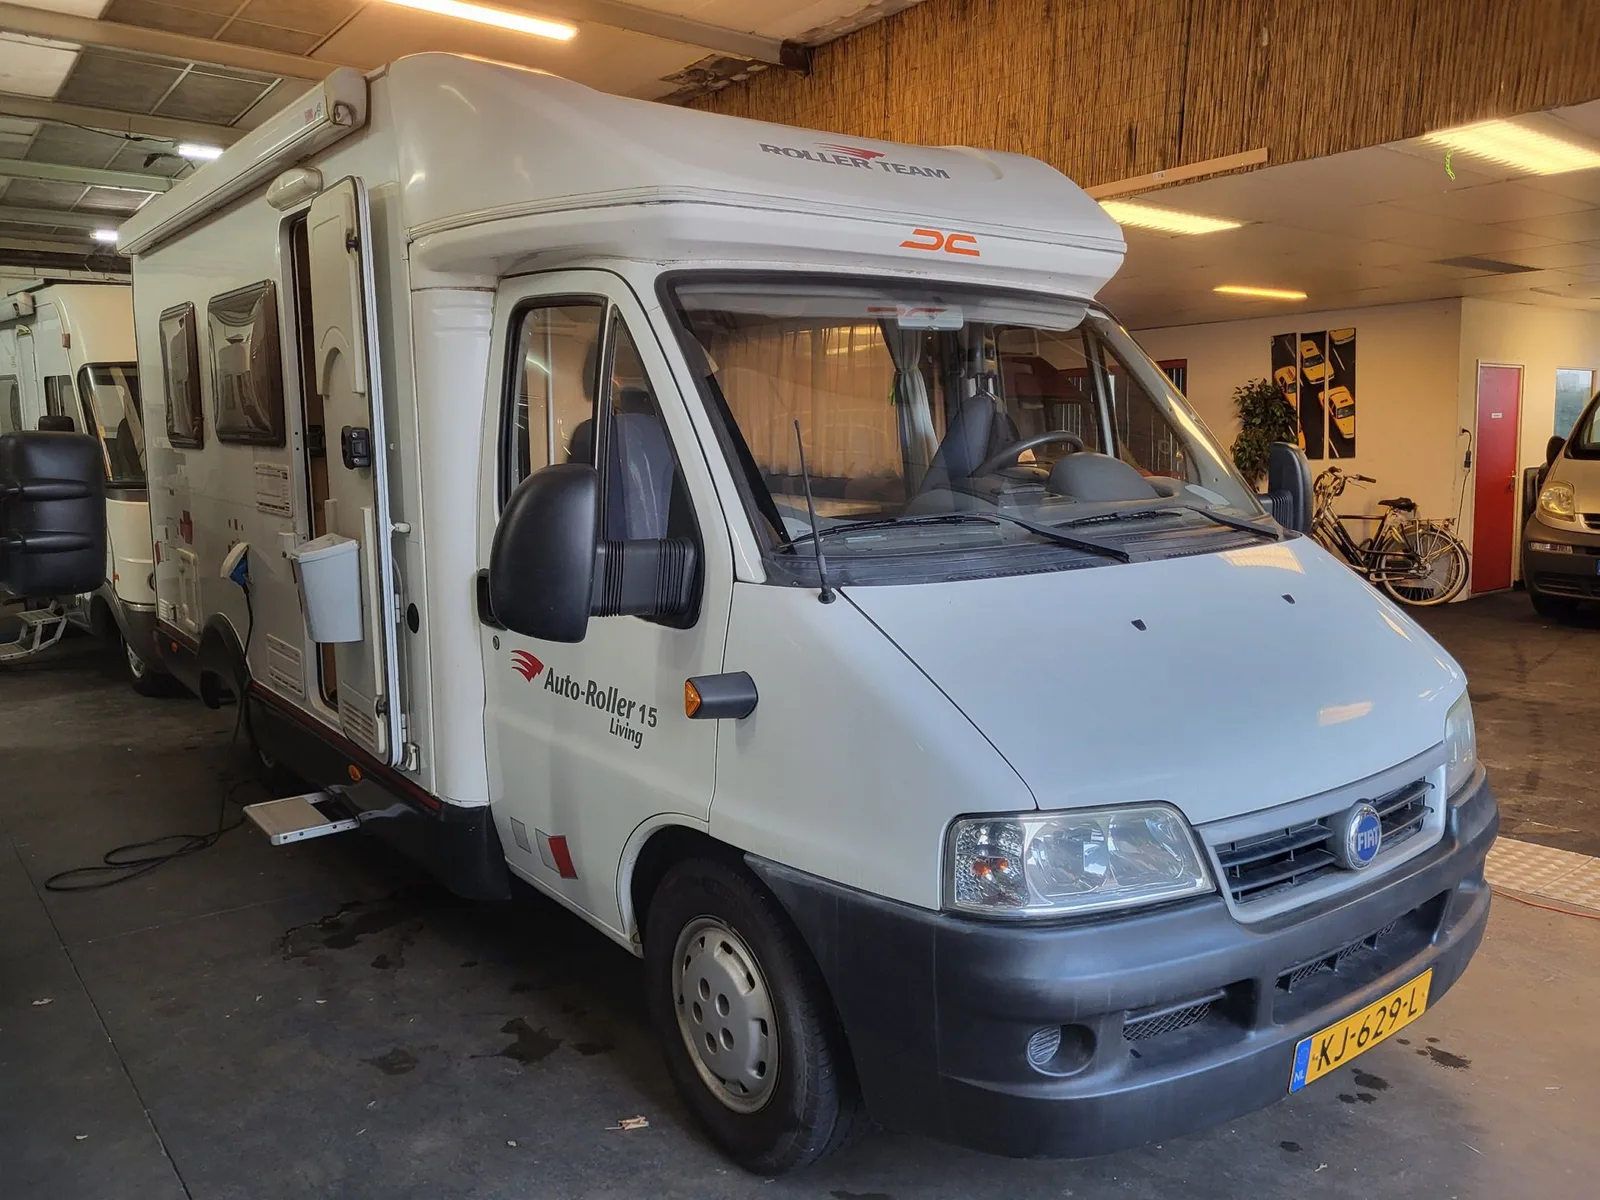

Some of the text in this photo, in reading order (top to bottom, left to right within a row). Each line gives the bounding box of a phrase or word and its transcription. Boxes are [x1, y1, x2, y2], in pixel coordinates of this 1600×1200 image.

[759, 143, 951, 179] ROLLER TEAM
[544, 667, 658, 728] Auto-Roller 15
[609, 717, 644, 750] Living
[1357, 825, 1379, 852] FIAT
[1316, 987, 1418, 1072] KJ-629-L
[1293, 1069, 1305, 1083] NL
